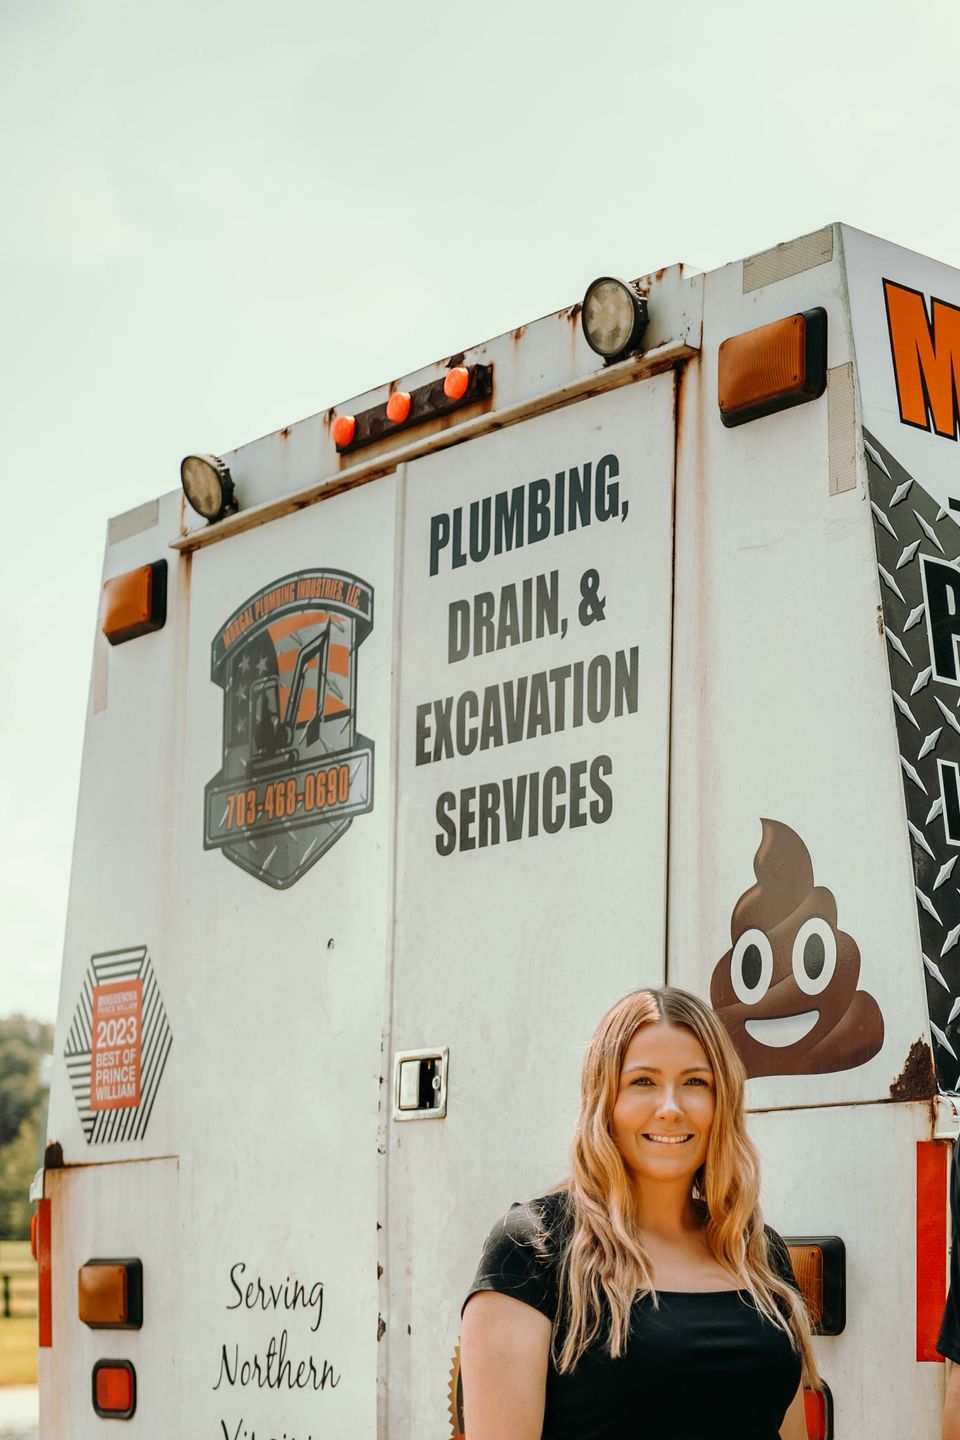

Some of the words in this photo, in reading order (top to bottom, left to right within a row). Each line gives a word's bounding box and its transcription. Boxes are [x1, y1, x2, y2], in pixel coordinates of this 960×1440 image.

[430, 453, 629, 576] PLUMBING,
[223, 607, 254, 650] MORGAL
[255, 583, 295, 619] PLUMBING
[448, 569, 567, 664] DRAIN,
[579, 568, 606, 627] &
[416, 647, 639, 766] EXCAVATION
[227, 767, 349, 829] 703-468-0690
[436, 755, 612, 856] SERVICES
[96, 1016, 138, 1048] 2023
[96, 1050, 120, 1067] BEST
[122, 1048, 136, 1063] OF
[96, 1065, 136, 1085] PRINCE
[96, 1081, 136, 1100] WILLIAM
[226, 1262, 325, 1331] Serving
[213, 1329, 341, 1391] Northern
